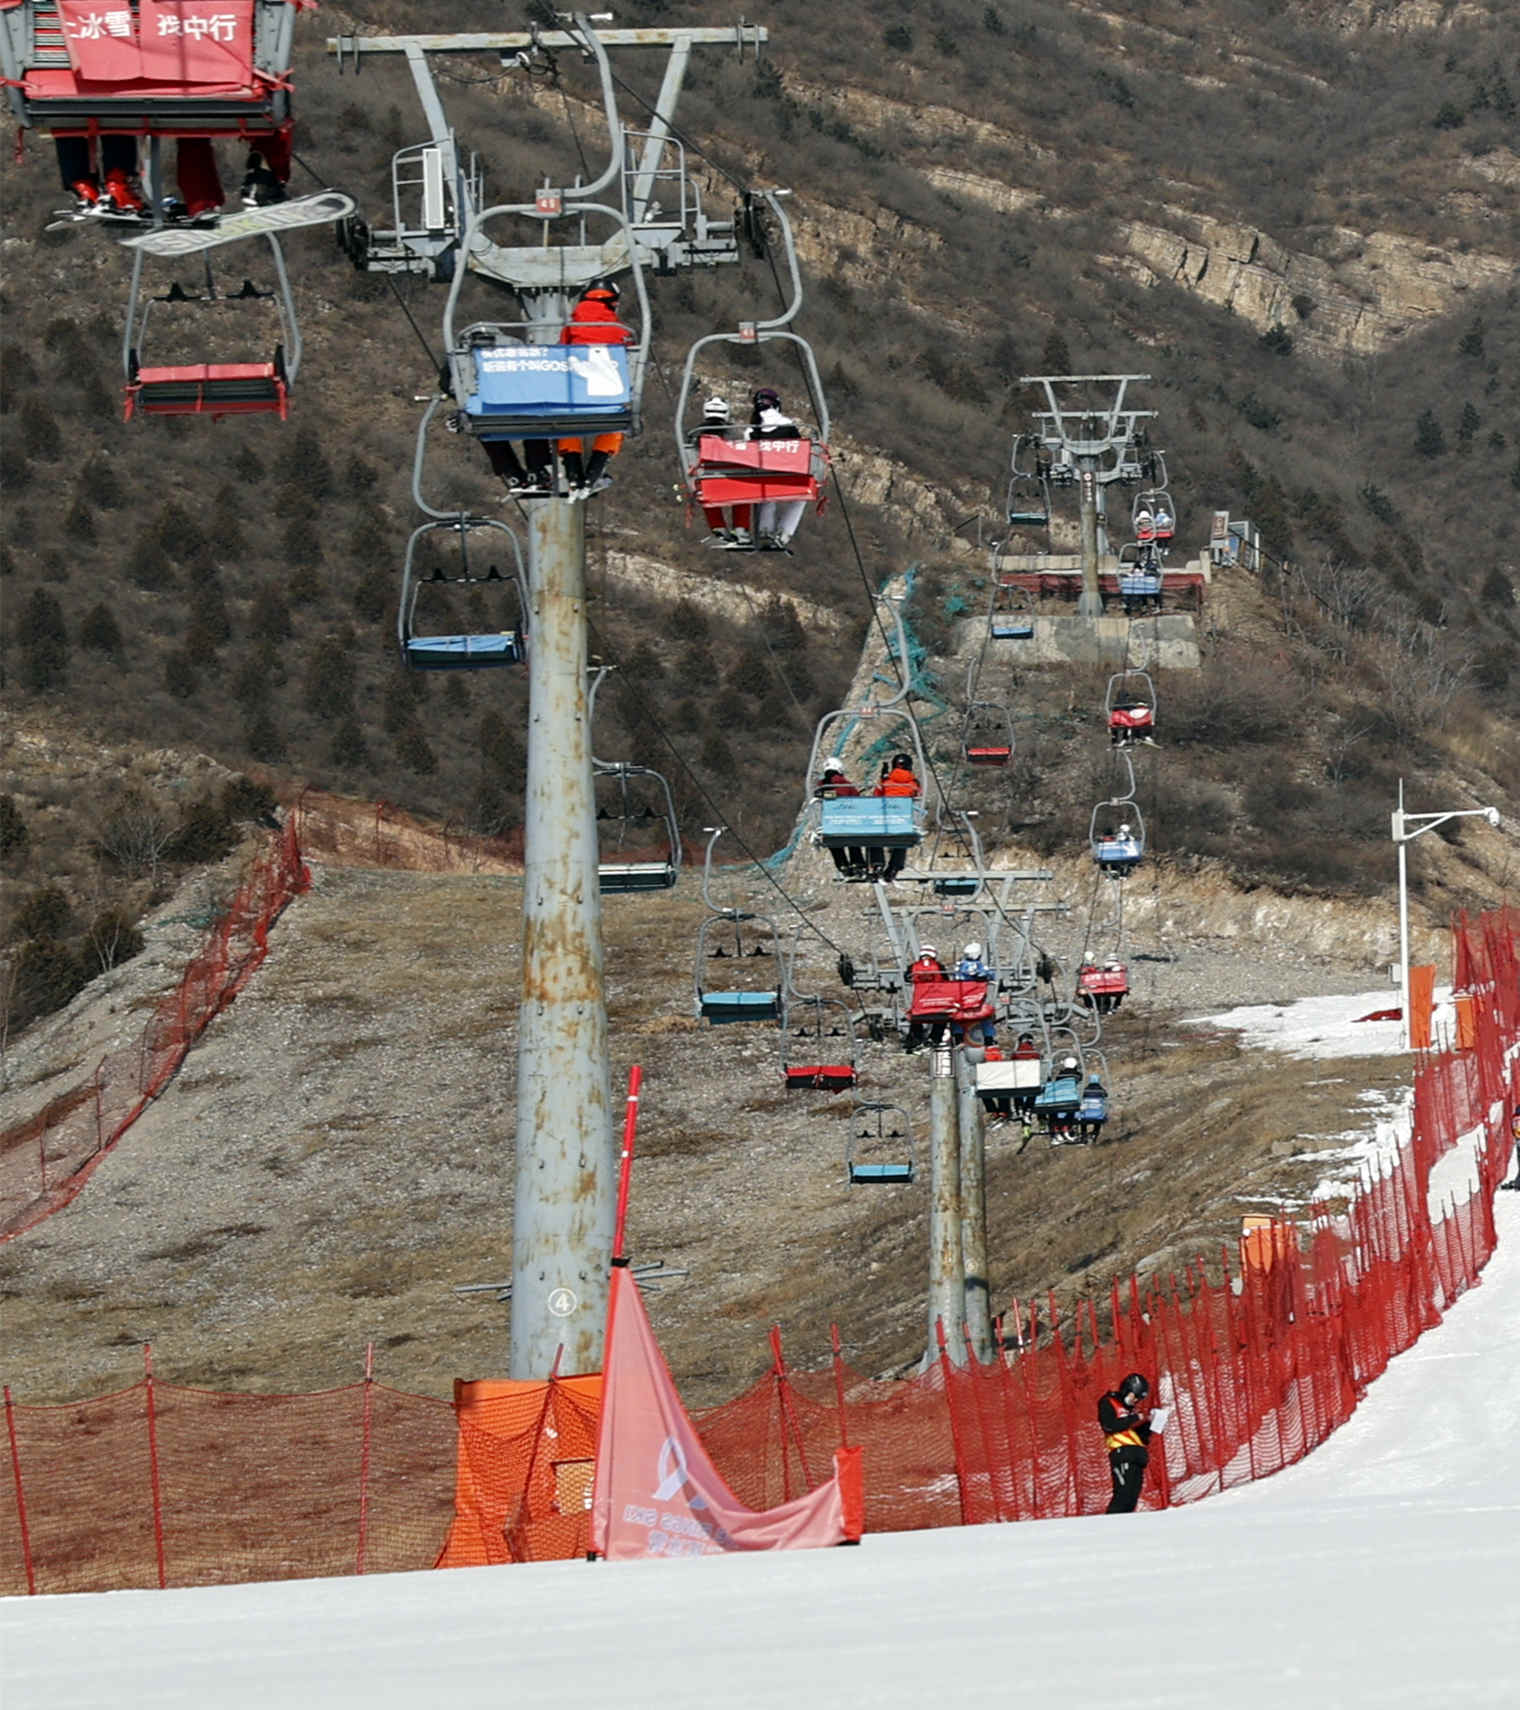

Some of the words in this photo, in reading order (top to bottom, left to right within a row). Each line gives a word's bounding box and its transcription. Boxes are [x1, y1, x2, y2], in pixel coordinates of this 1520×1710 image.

[157, 14, 237, 41] 找中行
[556, 1293, 568, 1311] 4
